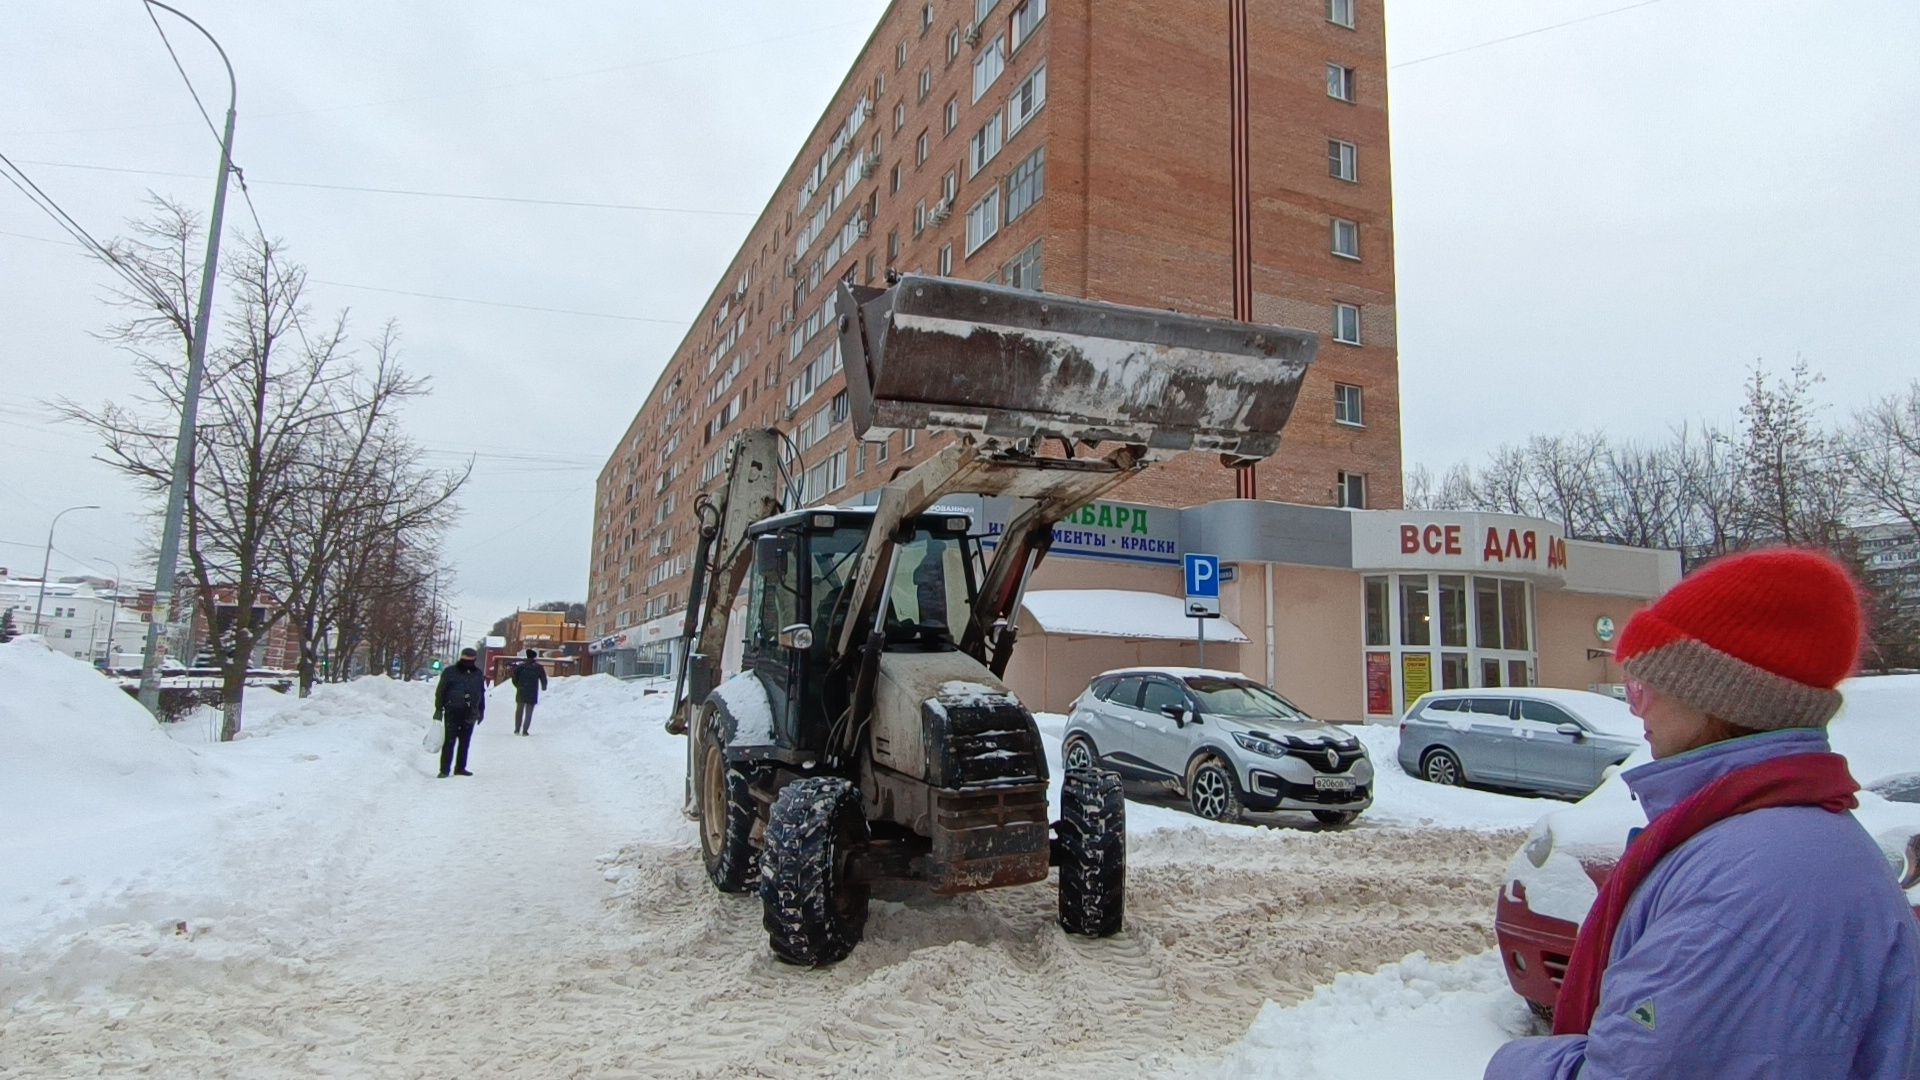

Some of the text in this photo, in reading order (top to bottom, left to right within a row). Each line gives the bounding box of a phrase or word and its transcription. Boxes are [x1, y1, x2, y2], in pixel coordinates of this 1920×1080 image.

[1061, 502, 1148, 535] МБАРД
[1121, 536, 1176, 554] КРАСКИ
[1400, 523, 1462, 555] ВСЕ
[1483, 526, 1537, 563] ДЛЯ
[1194, 559, 1213, 592] P
